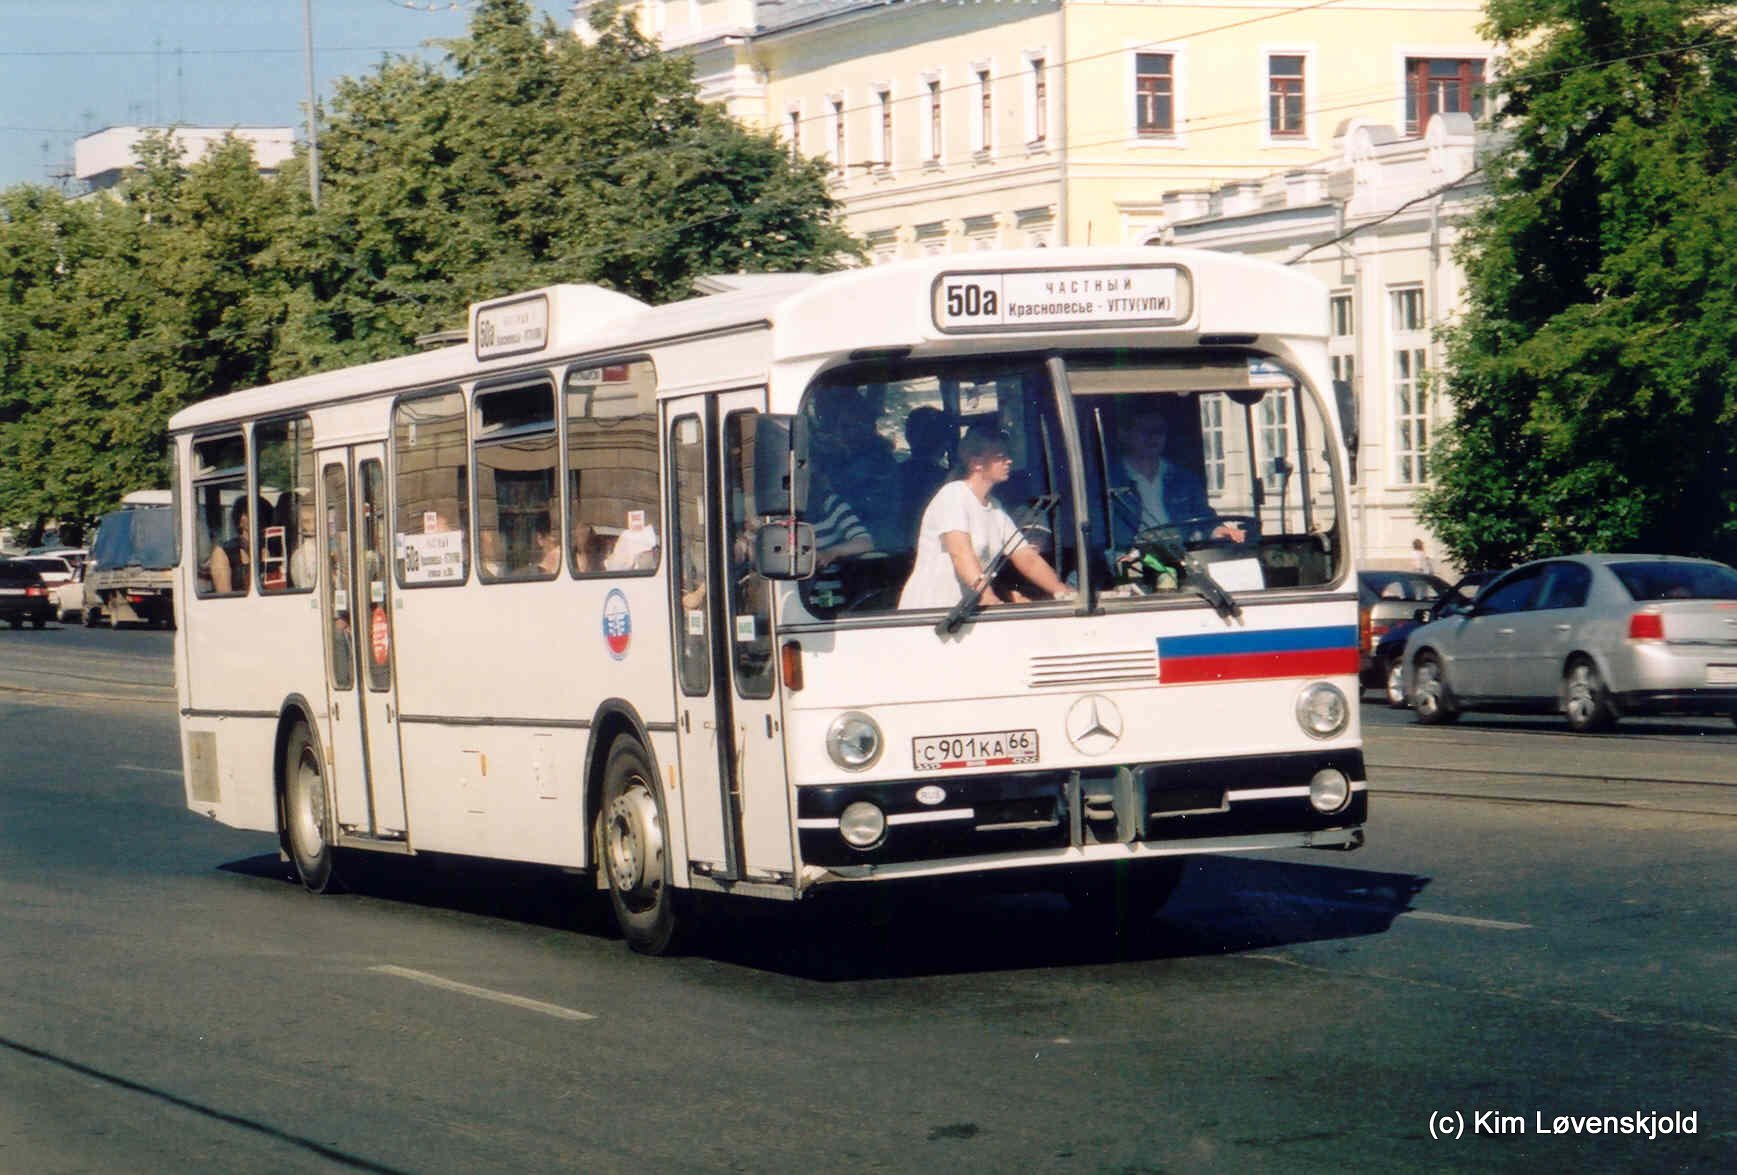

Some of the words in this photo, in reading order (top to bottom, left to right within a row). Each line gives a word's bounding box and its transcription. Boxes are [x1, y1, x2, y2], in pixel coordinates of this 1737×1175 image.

[946, 284, 998, 317] 50а
[1008, 298, 1093, 318] Краснолесье
[1107, 295, 1171, 313] УГТУ(УПИ)
